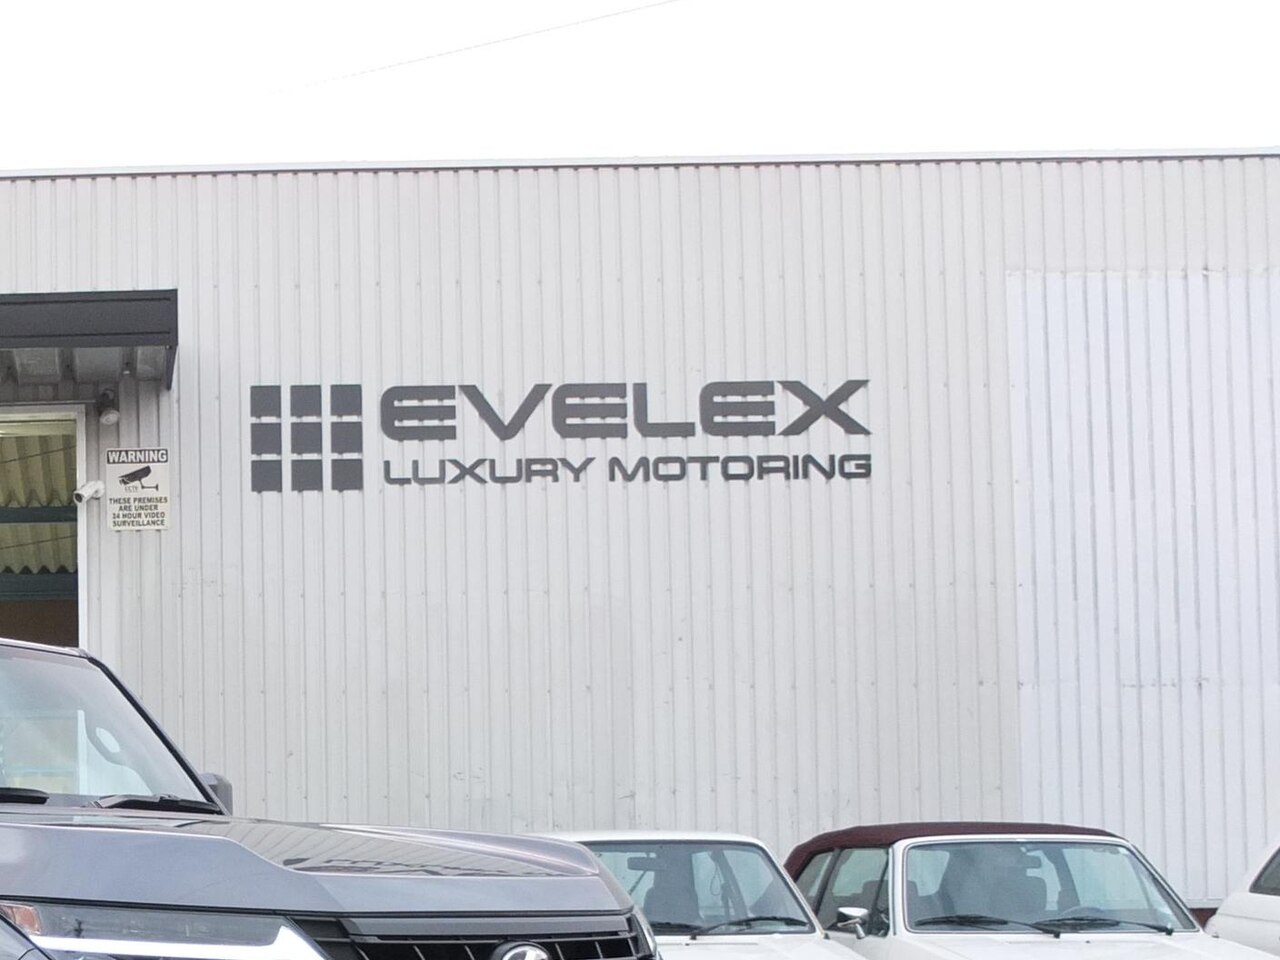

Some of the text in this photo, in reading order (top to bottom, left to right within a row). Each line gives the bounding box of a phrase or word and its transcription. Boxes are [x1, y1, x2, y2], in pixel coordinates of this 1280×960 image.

[380, 379, 872, 441] EVELEX
[108, 450, 167, 463] WARNING
[384, 454, 872, 485] LUXURY MOTORING
[133, 496, 168, 504] PREMISES
[112, 519, 166, 527] SURVEILLANCE
